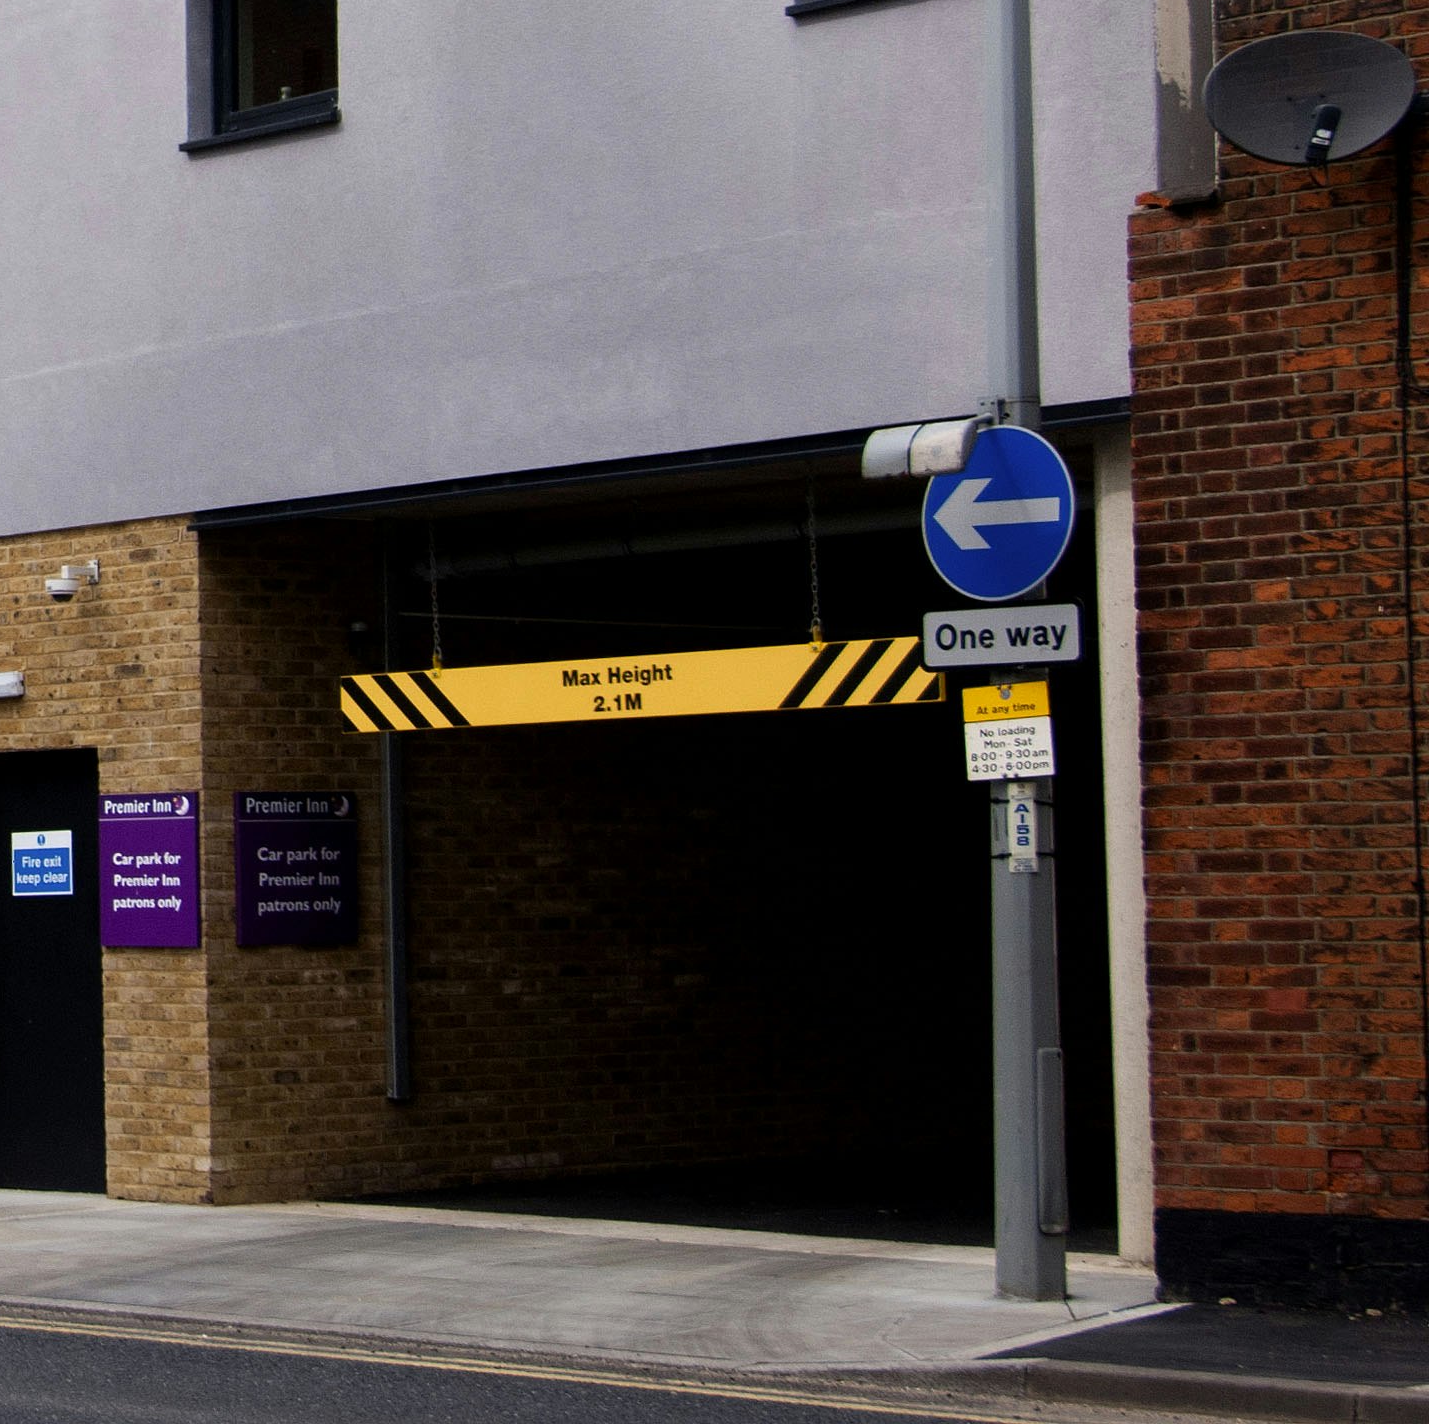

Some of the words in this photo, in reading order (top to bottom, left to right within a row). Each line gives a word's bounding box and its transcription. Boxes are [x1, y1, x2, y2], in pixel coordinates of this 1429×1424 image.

[935, 623, 994, 651] One
[1005, 624, 1067, 651] way
[562, 669, 602, 687] Max
[607, 664, 673, 686] Height
[593, 693, 642, 712] 2.1M
[976, 706, 989, 715] At
[992, 705, 1009, 714] any
[1012, 703, 1036, 712] time
[979, 729, 994, 737] No
[997, 726, 1036, 737] loading
[984, 740, 1006, 749] Mon
[1013, 737, 1033, 747] Sat
[104, 800, 150, 814] Premier
[152, 799, 172, 813] Inn
[246, 797, 303, 813] Premier
[306, 797, 328, 813] Inn
[22, 856, 41, 868] Fire
[43, 855, 62, 867] exit
[112, 853, 134, 865] Car
[136, 852, 162, 868] park
[163, 851, 181, 865] for
[257, 847, 283, 862] Car
[286, 847, 318, 865] park
[321, 846, 340, 861] for
[16, 872, 41, 886] keep
[43, 871, 68, 884] clear
[113, 874, 160, 887] Premier
[162, 873, 181, 886] Inn
[258, 872, 315, 887] Premier
[318, 871, 340, 886] Inn
[113, 897, 155, 912] patrons
[157, 896, 182, 912] only
[258, 900, 310, 917] patrons
[313, 896, 341, 915] only
